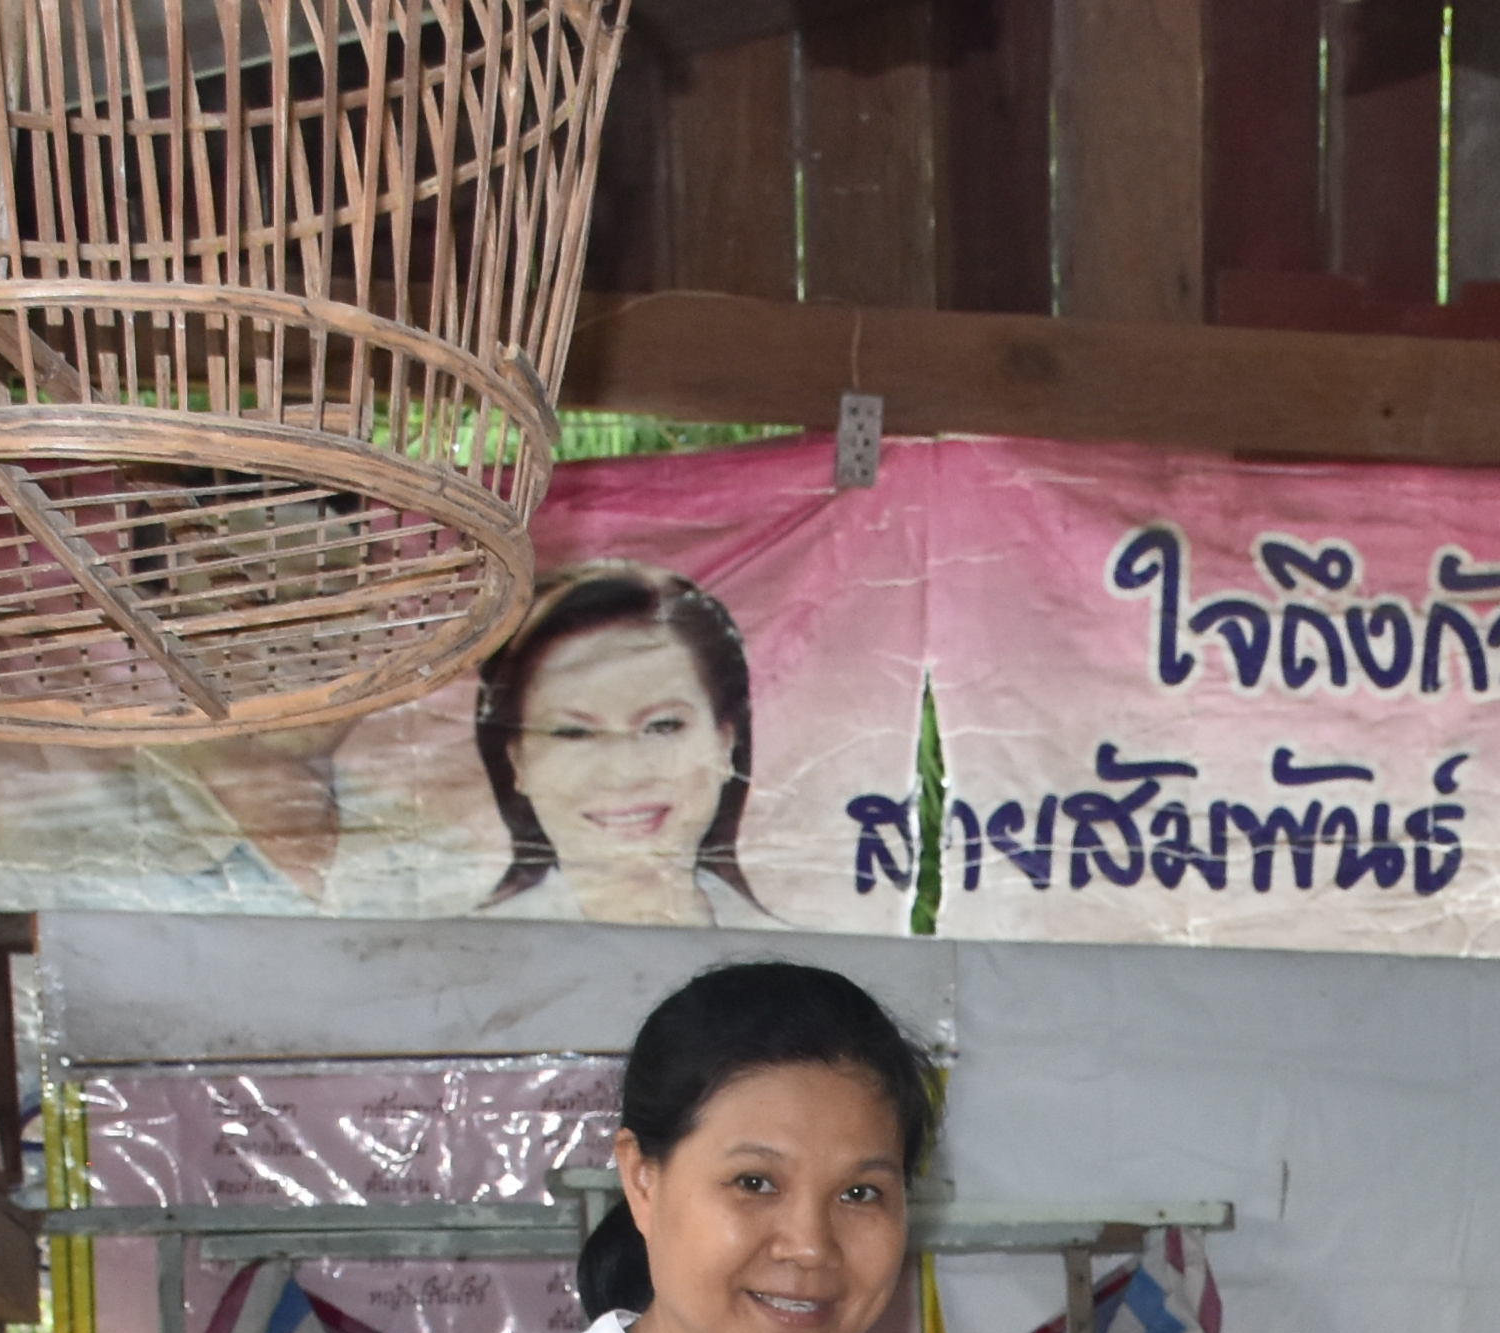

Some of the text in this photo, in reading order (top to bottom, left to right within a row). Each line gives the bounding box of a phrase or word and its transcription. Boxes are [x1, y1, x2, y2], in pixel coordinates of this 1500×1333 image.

[845, 742, 1470, 896] สายสัมพันธ์
